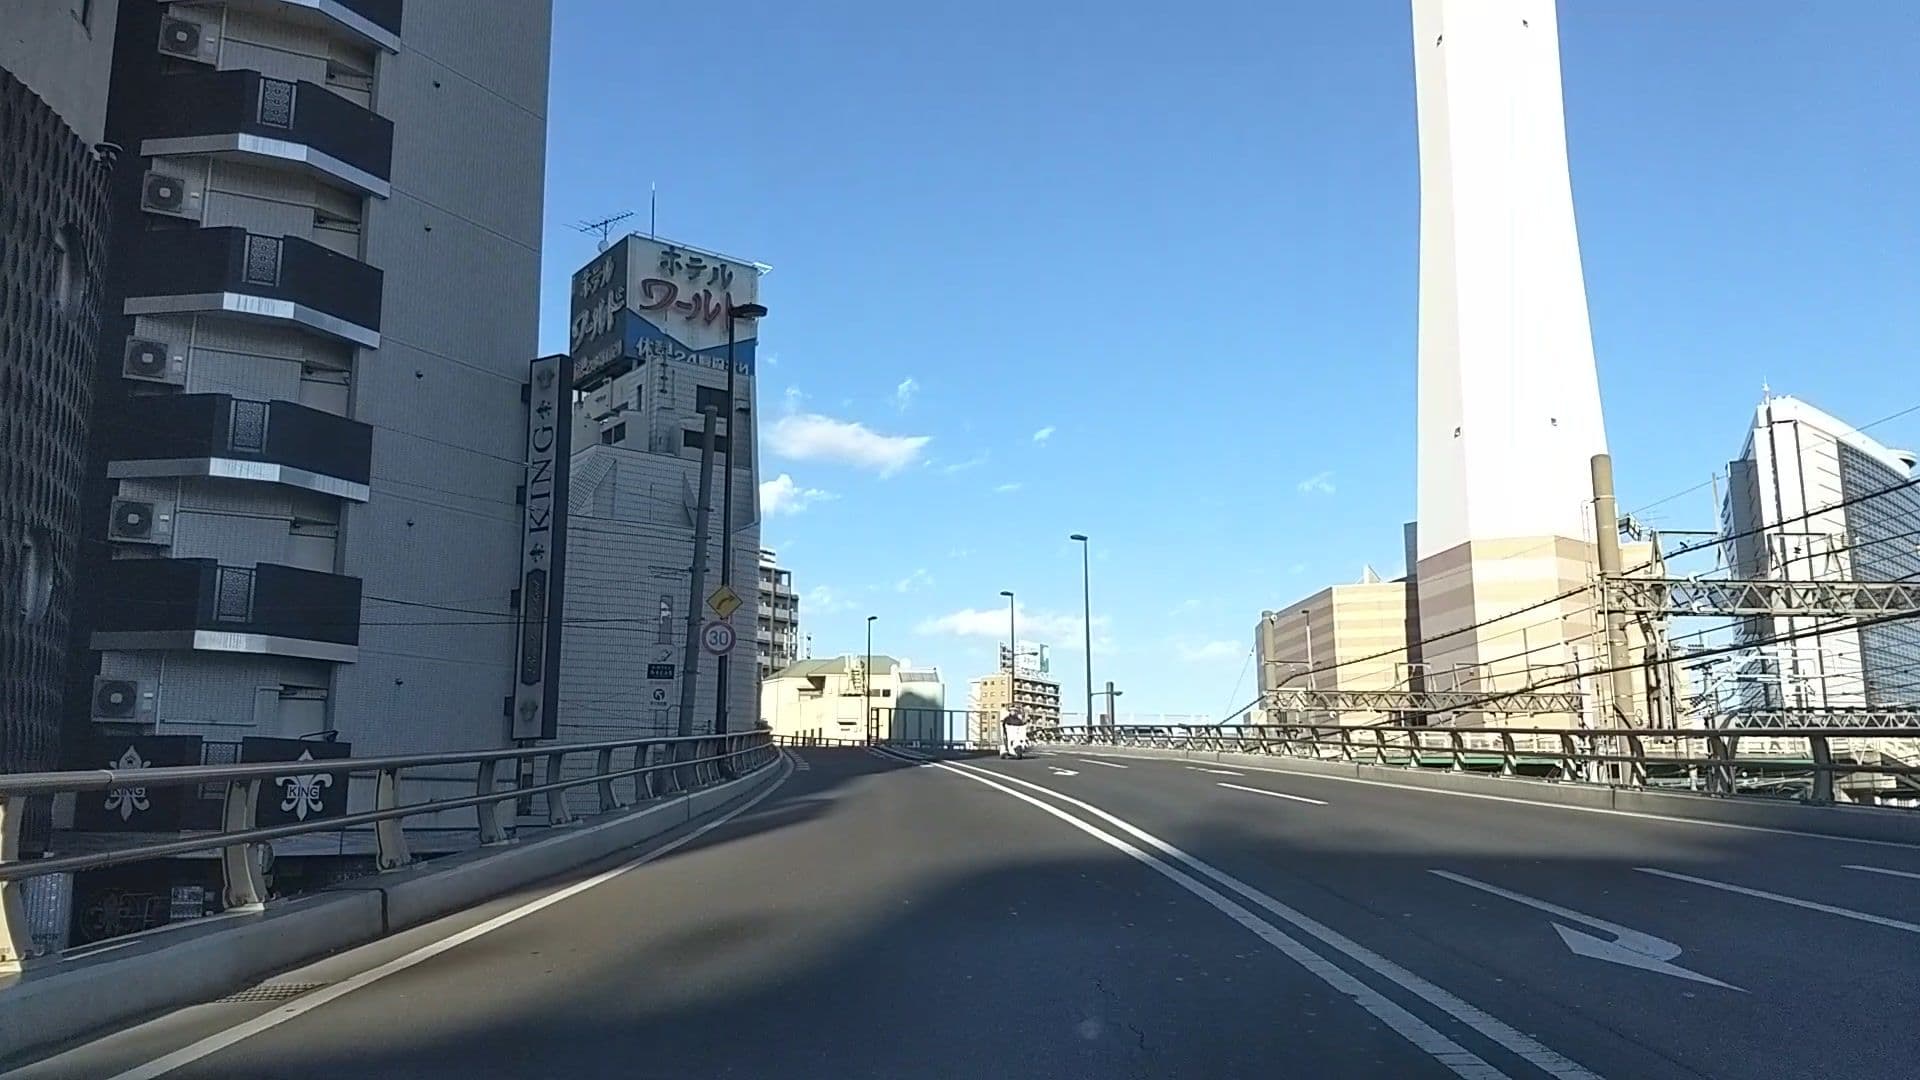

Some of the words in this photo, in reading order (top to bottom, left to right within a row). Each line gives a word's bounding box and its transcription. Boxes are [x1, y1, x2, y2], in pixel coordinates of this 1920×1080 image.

[581, 255, 615, 298] ホテル
[659, 245, 735, 289] ホテル
[530, 424, 554, 535] KING
[709, 630, 729, 646] 30
[288, 785, 320, 798] KING
